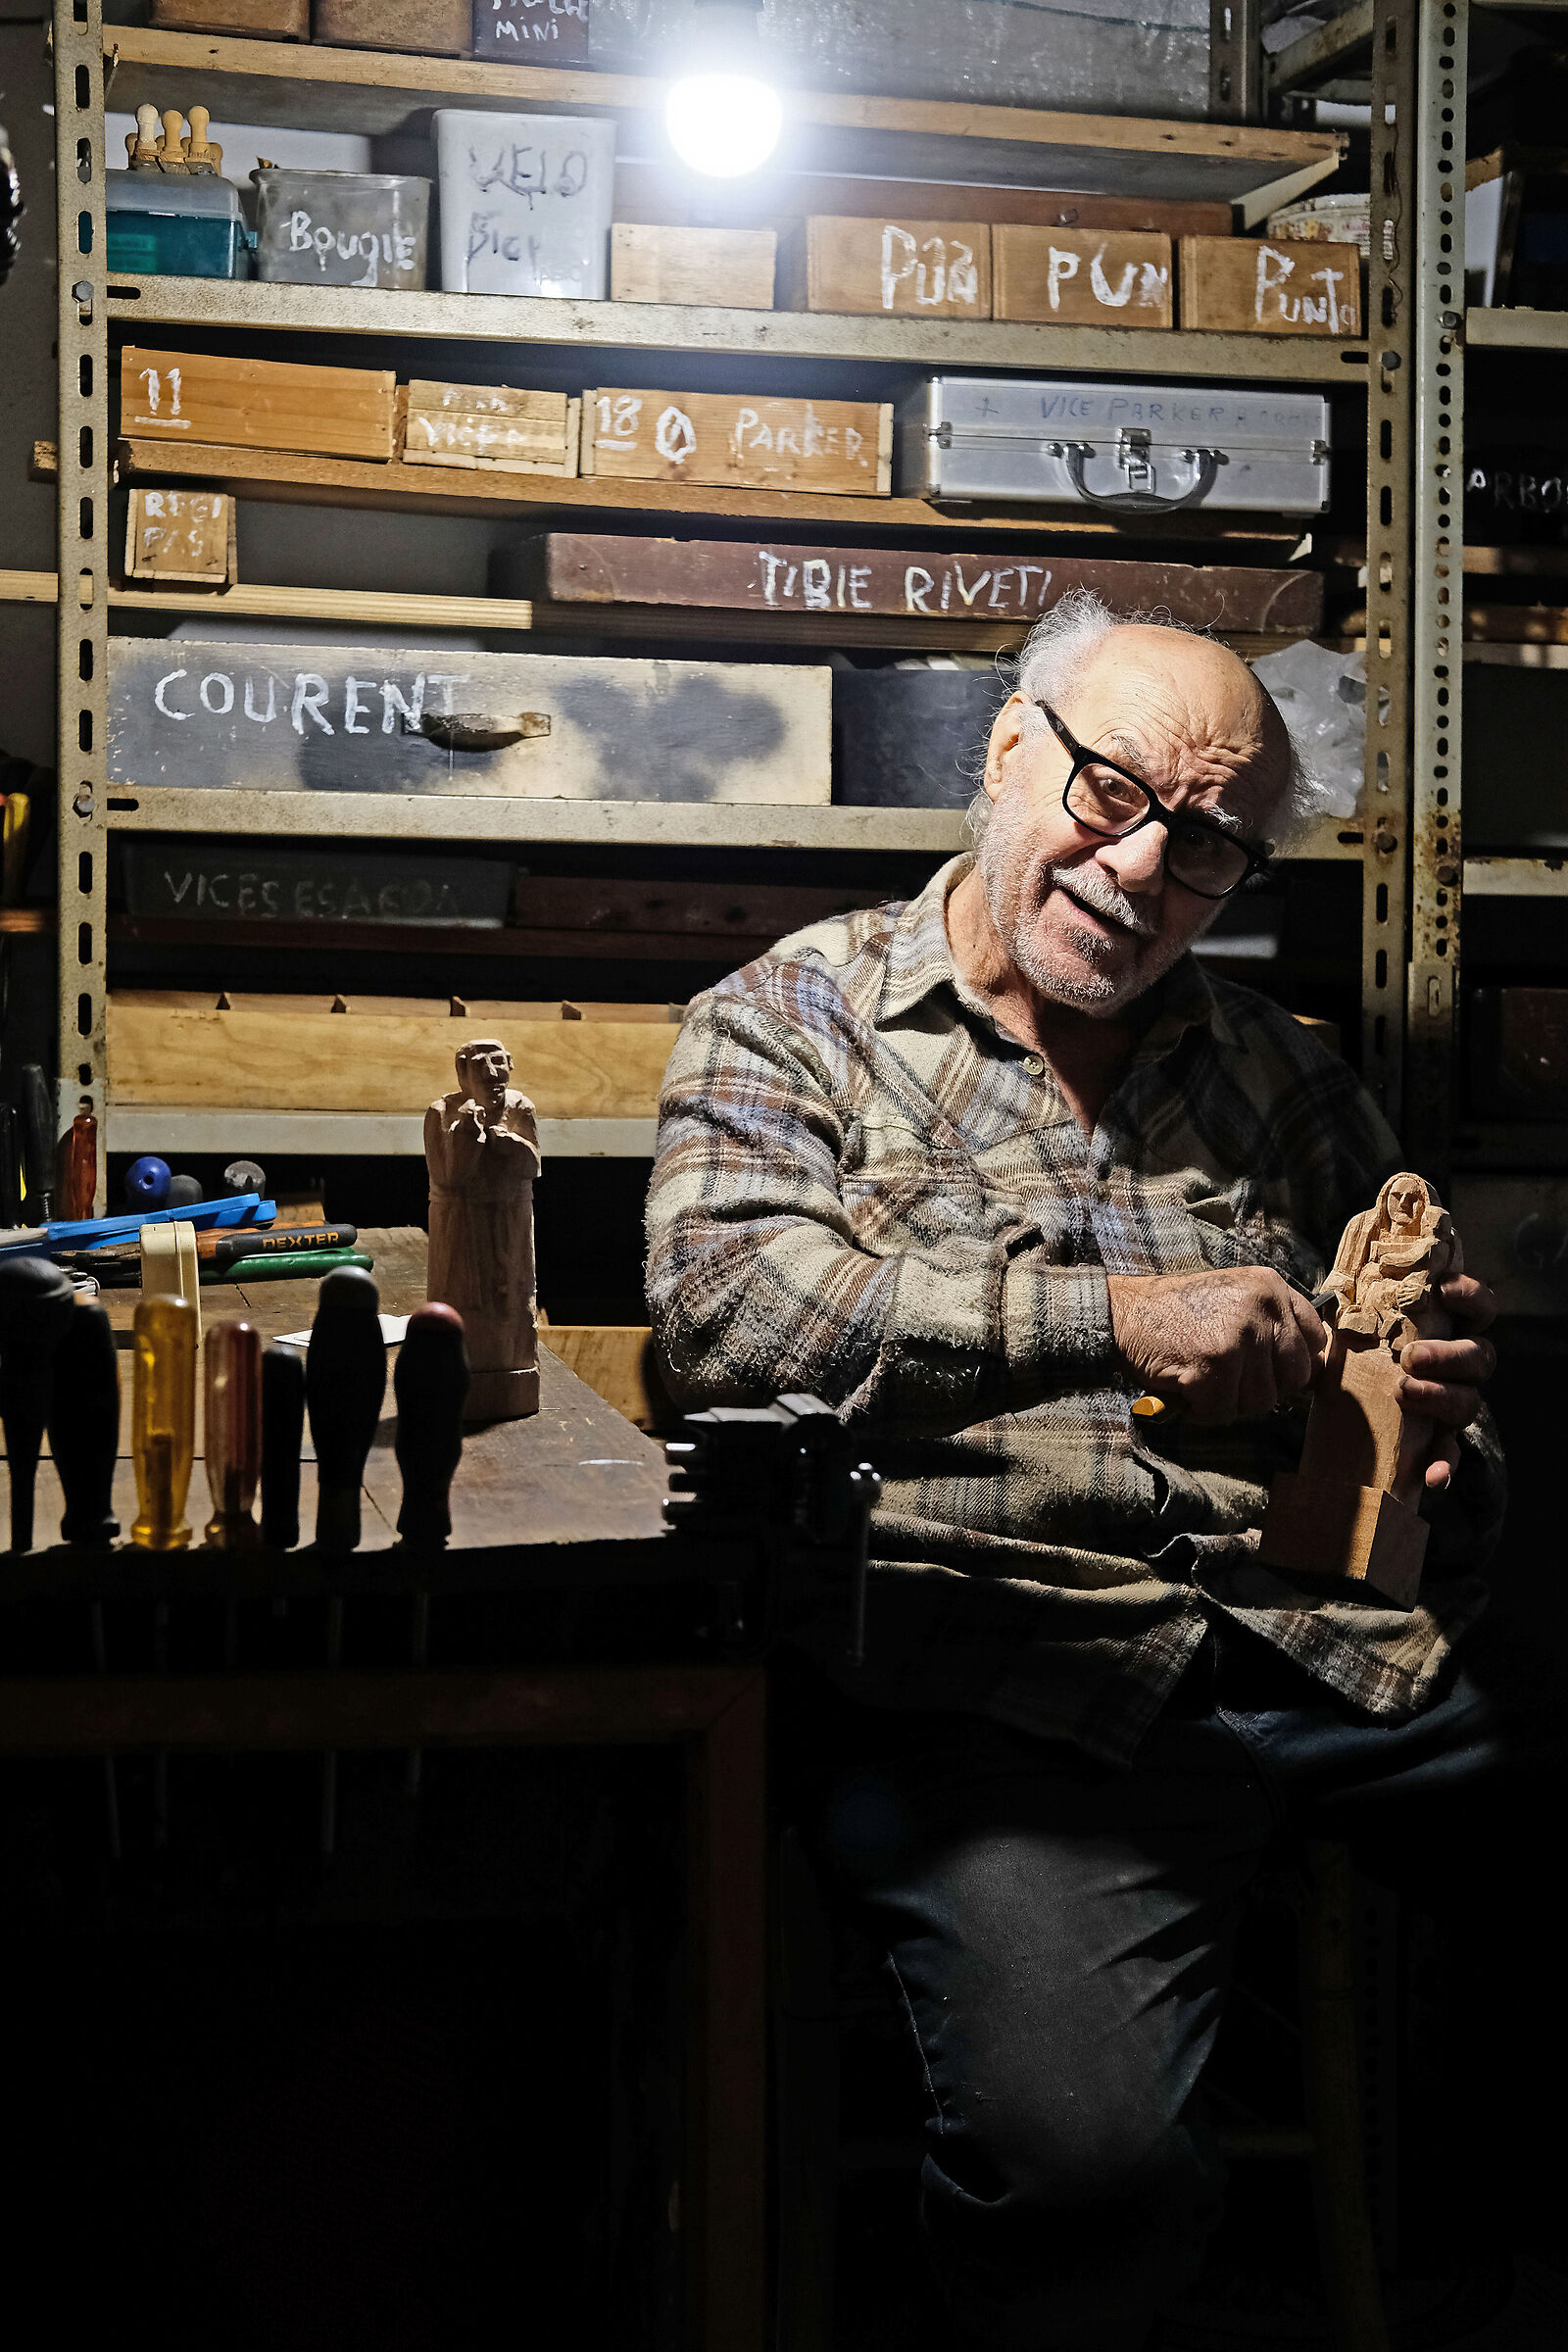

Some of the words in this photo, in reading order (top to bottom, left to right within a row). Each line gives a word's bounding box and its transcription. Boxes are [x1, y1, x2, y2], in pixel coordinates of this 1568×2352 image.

[594, 394, 643, 436] 18
[1465, 466, 1568, 514] ARBO
[262, 1232, 339, 1250] DEXTER
